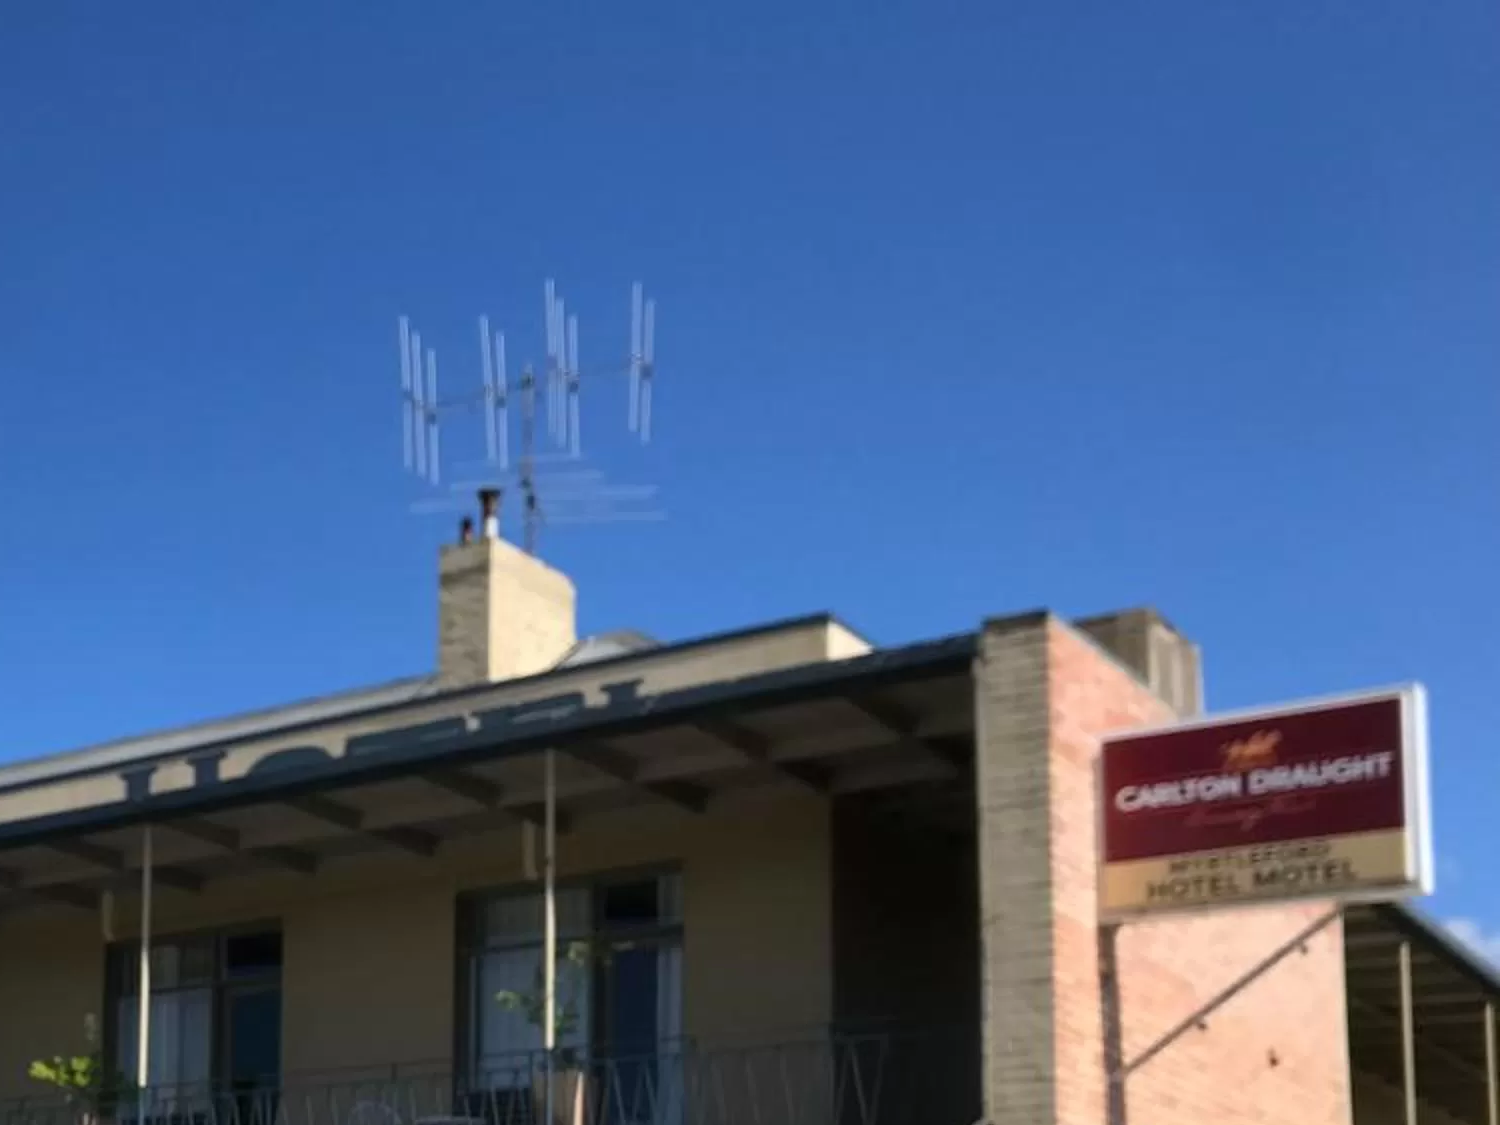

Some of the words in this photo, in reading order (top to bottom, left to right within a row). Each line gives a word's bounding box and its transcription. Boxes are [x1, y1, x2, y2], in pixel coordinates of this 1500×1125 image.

[1114, 772, 1243, 812] CARLTON
[1249, 752, 1392, 794] DRAUGHT
[1146, 870, 1240, 900] HOTEL
[1253, 856, 1358, 887] MOTEL
